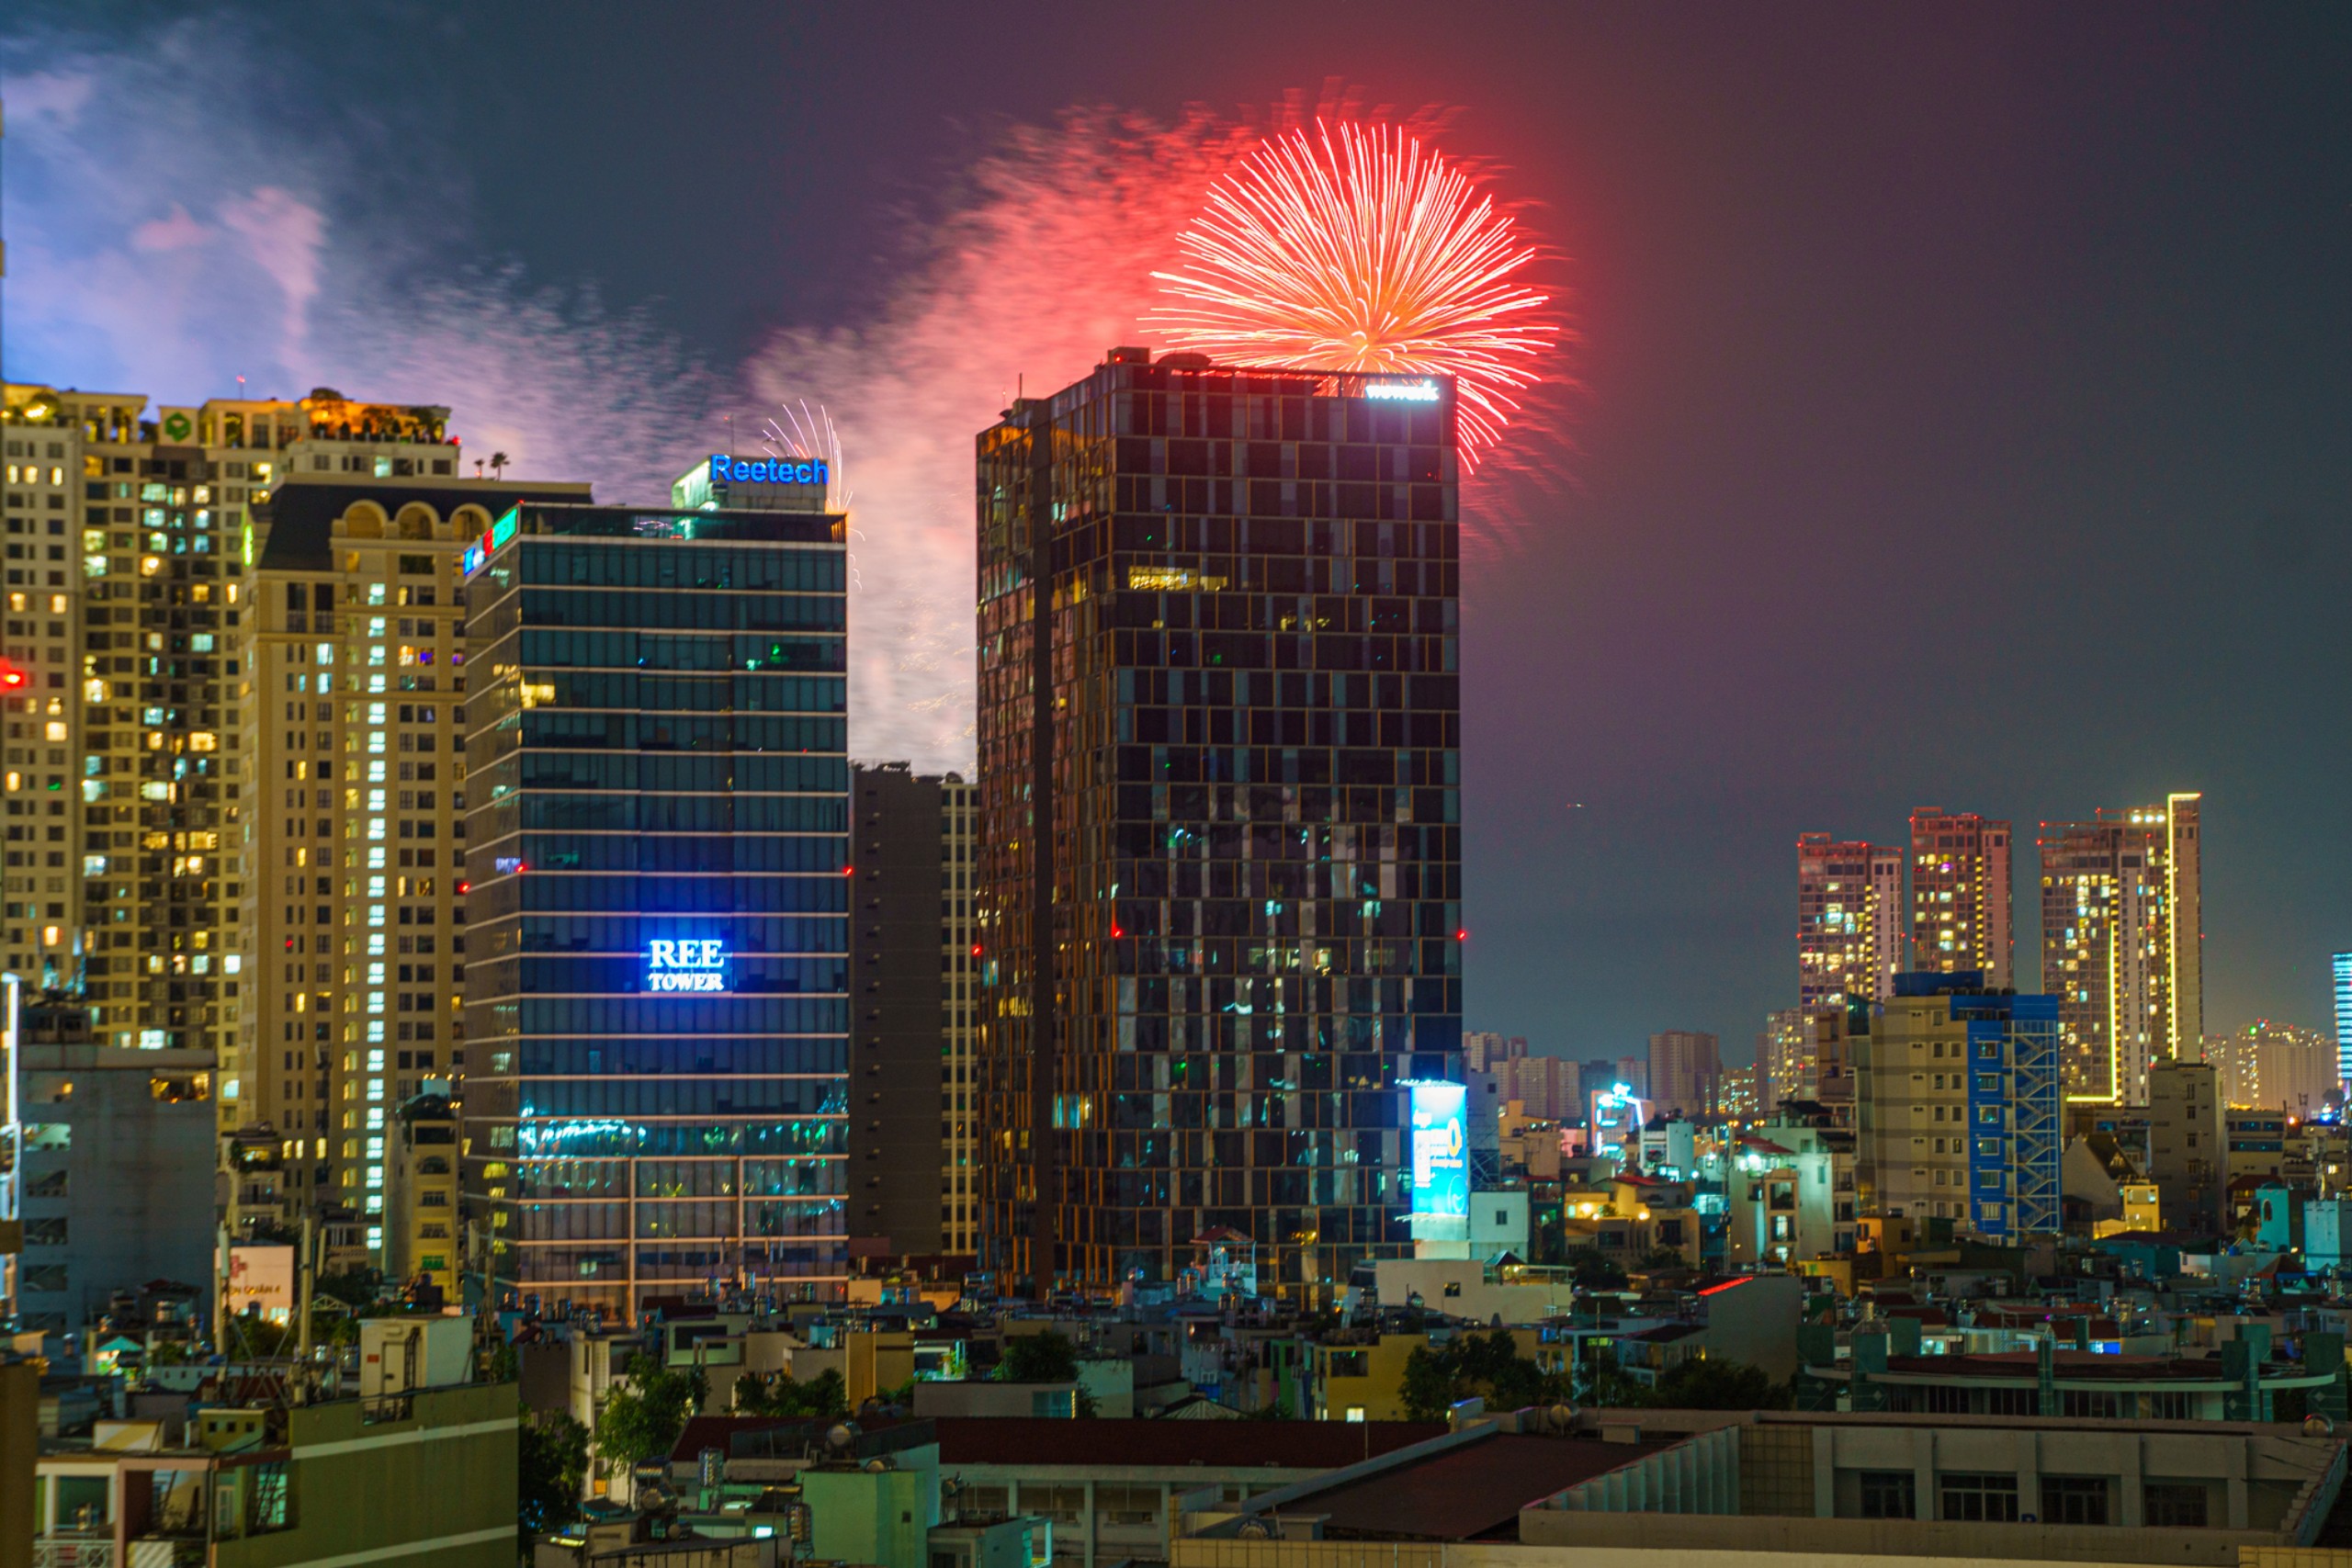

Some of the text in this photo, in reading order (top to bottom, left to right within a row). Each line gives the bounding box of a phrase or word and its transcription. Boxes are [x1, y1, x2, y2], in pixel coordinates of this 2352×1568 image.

[710, 454, 829, 484] Reetech
[649, 939, 725, 969] REE
[648, 973, 725, 991] TOWER
